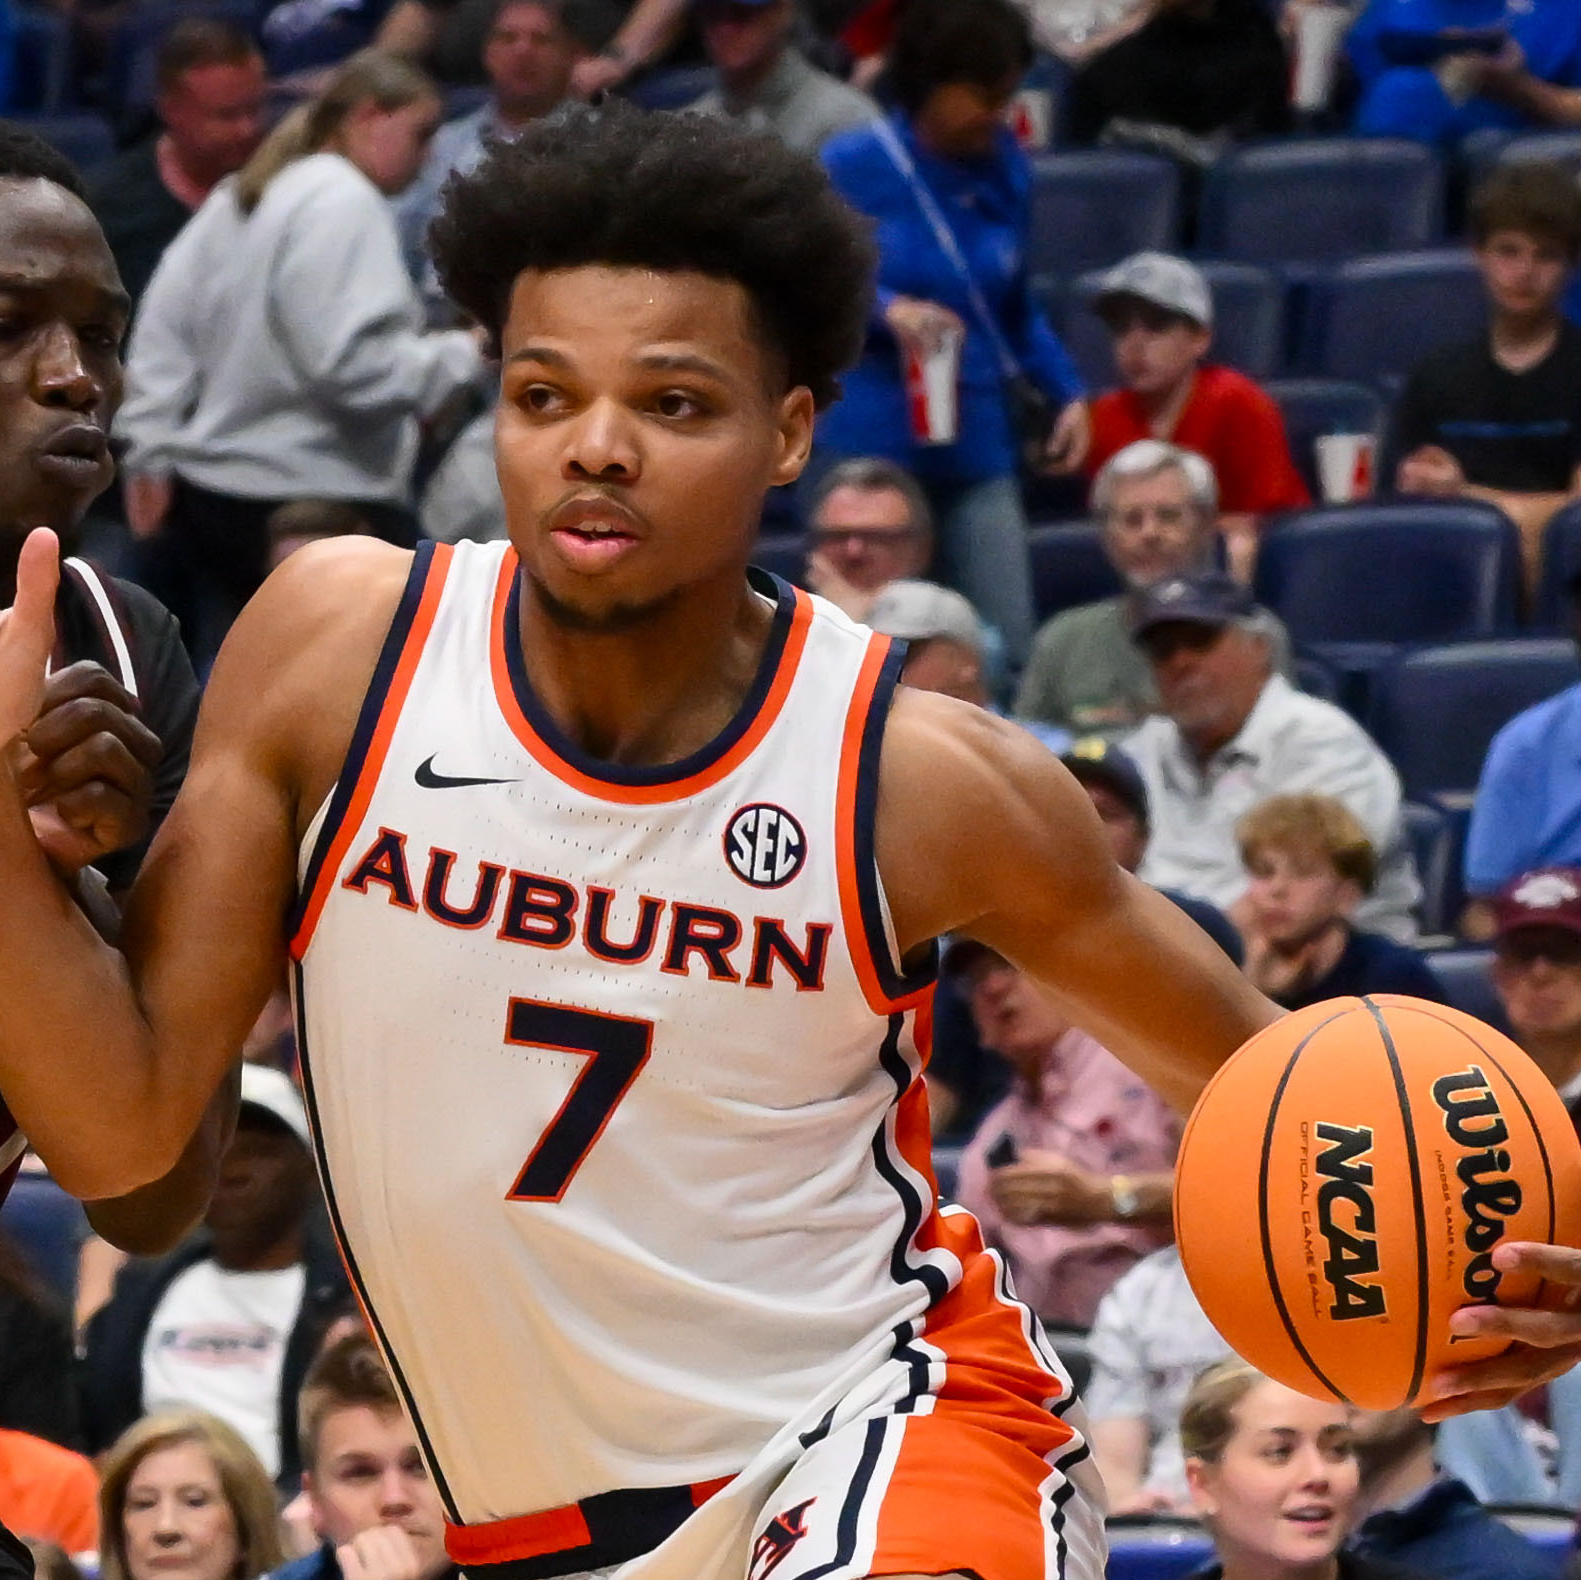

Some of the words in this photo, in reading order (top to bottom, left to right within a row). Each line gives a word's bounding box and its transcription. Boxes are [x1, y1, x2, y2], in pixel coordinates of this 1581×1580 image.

[730, 807, 801, 882] SEC
[342, 826, 833, 992] AUBURN
[504, 996, 655, 1204] 7
[1300, 1121, 1309, 1205] OFFICIAL
[1314, 1121, 1388, 1321] NCAA
[1430, 1064, 1522, 1344] Wilso
[1301, 1210, 1315, 1266] GAME
[1307, 1272, 1322, 1320] BALL
